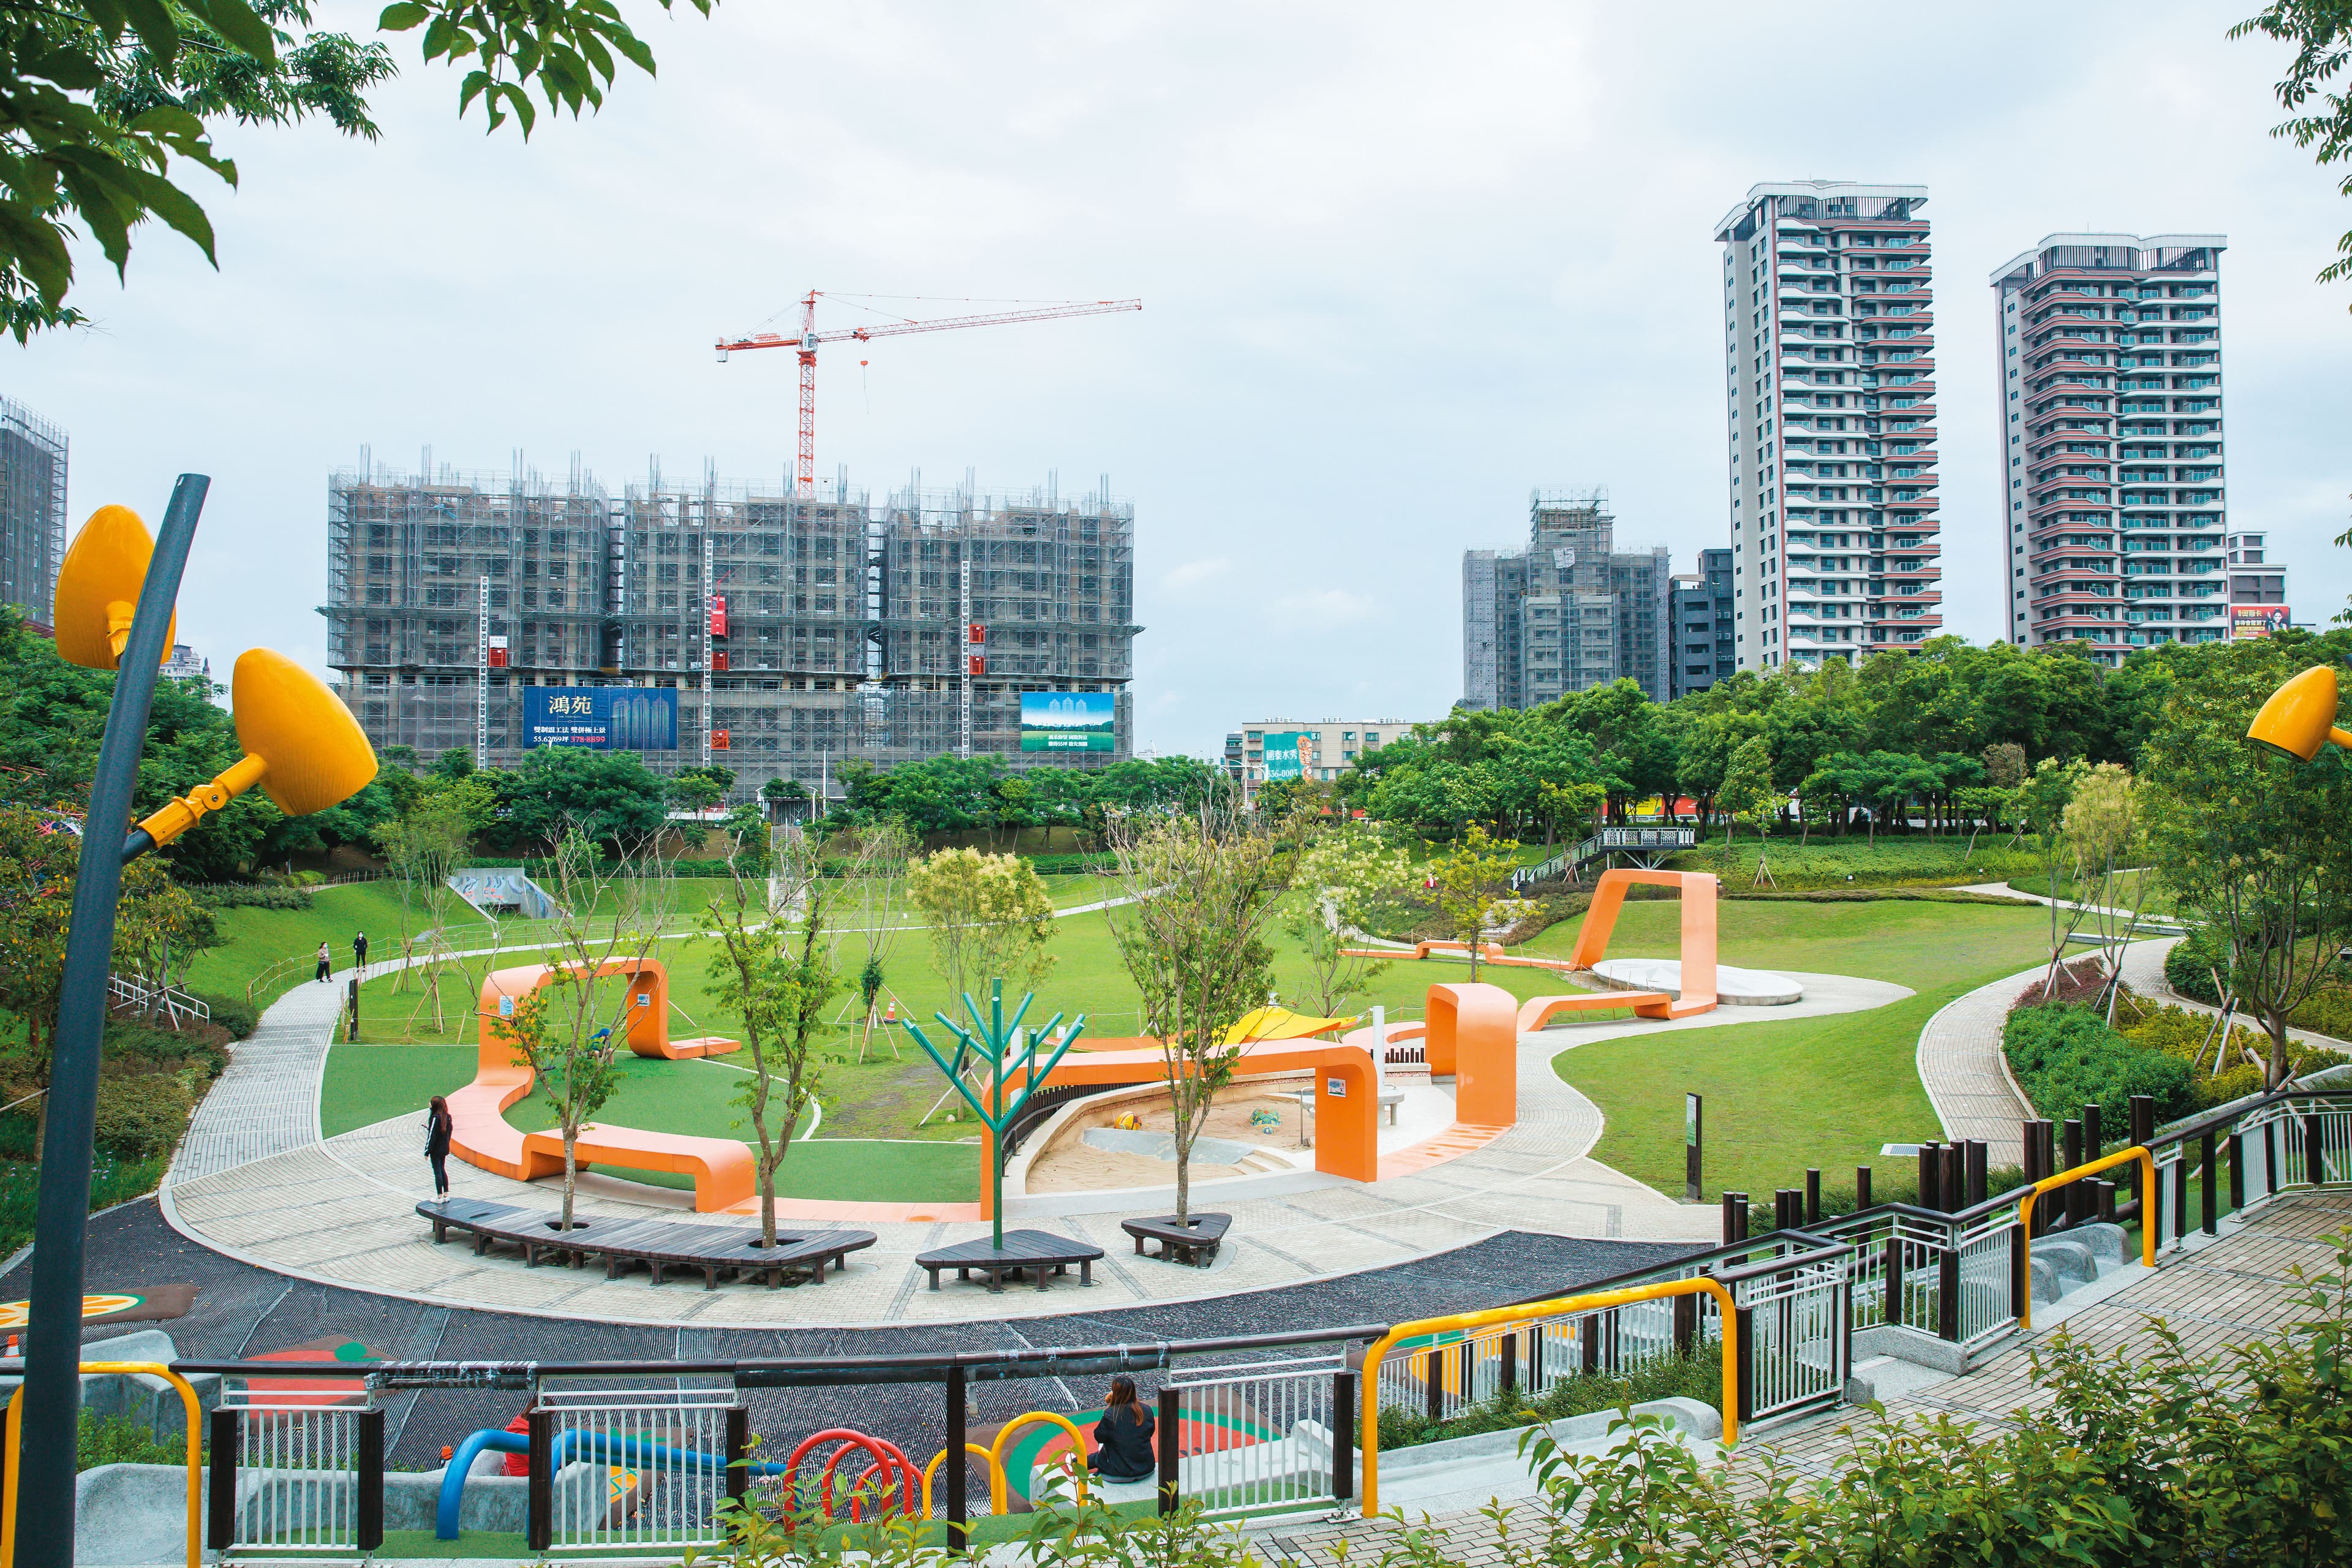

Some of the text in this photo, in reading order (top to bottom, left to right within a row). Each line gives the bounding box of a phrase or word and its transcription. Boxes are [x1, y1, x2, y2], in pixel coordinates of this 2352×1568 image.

[549, 695, 592, 714] 鴻苑
[1266, 749, 1297, 761] 國泰水秀
